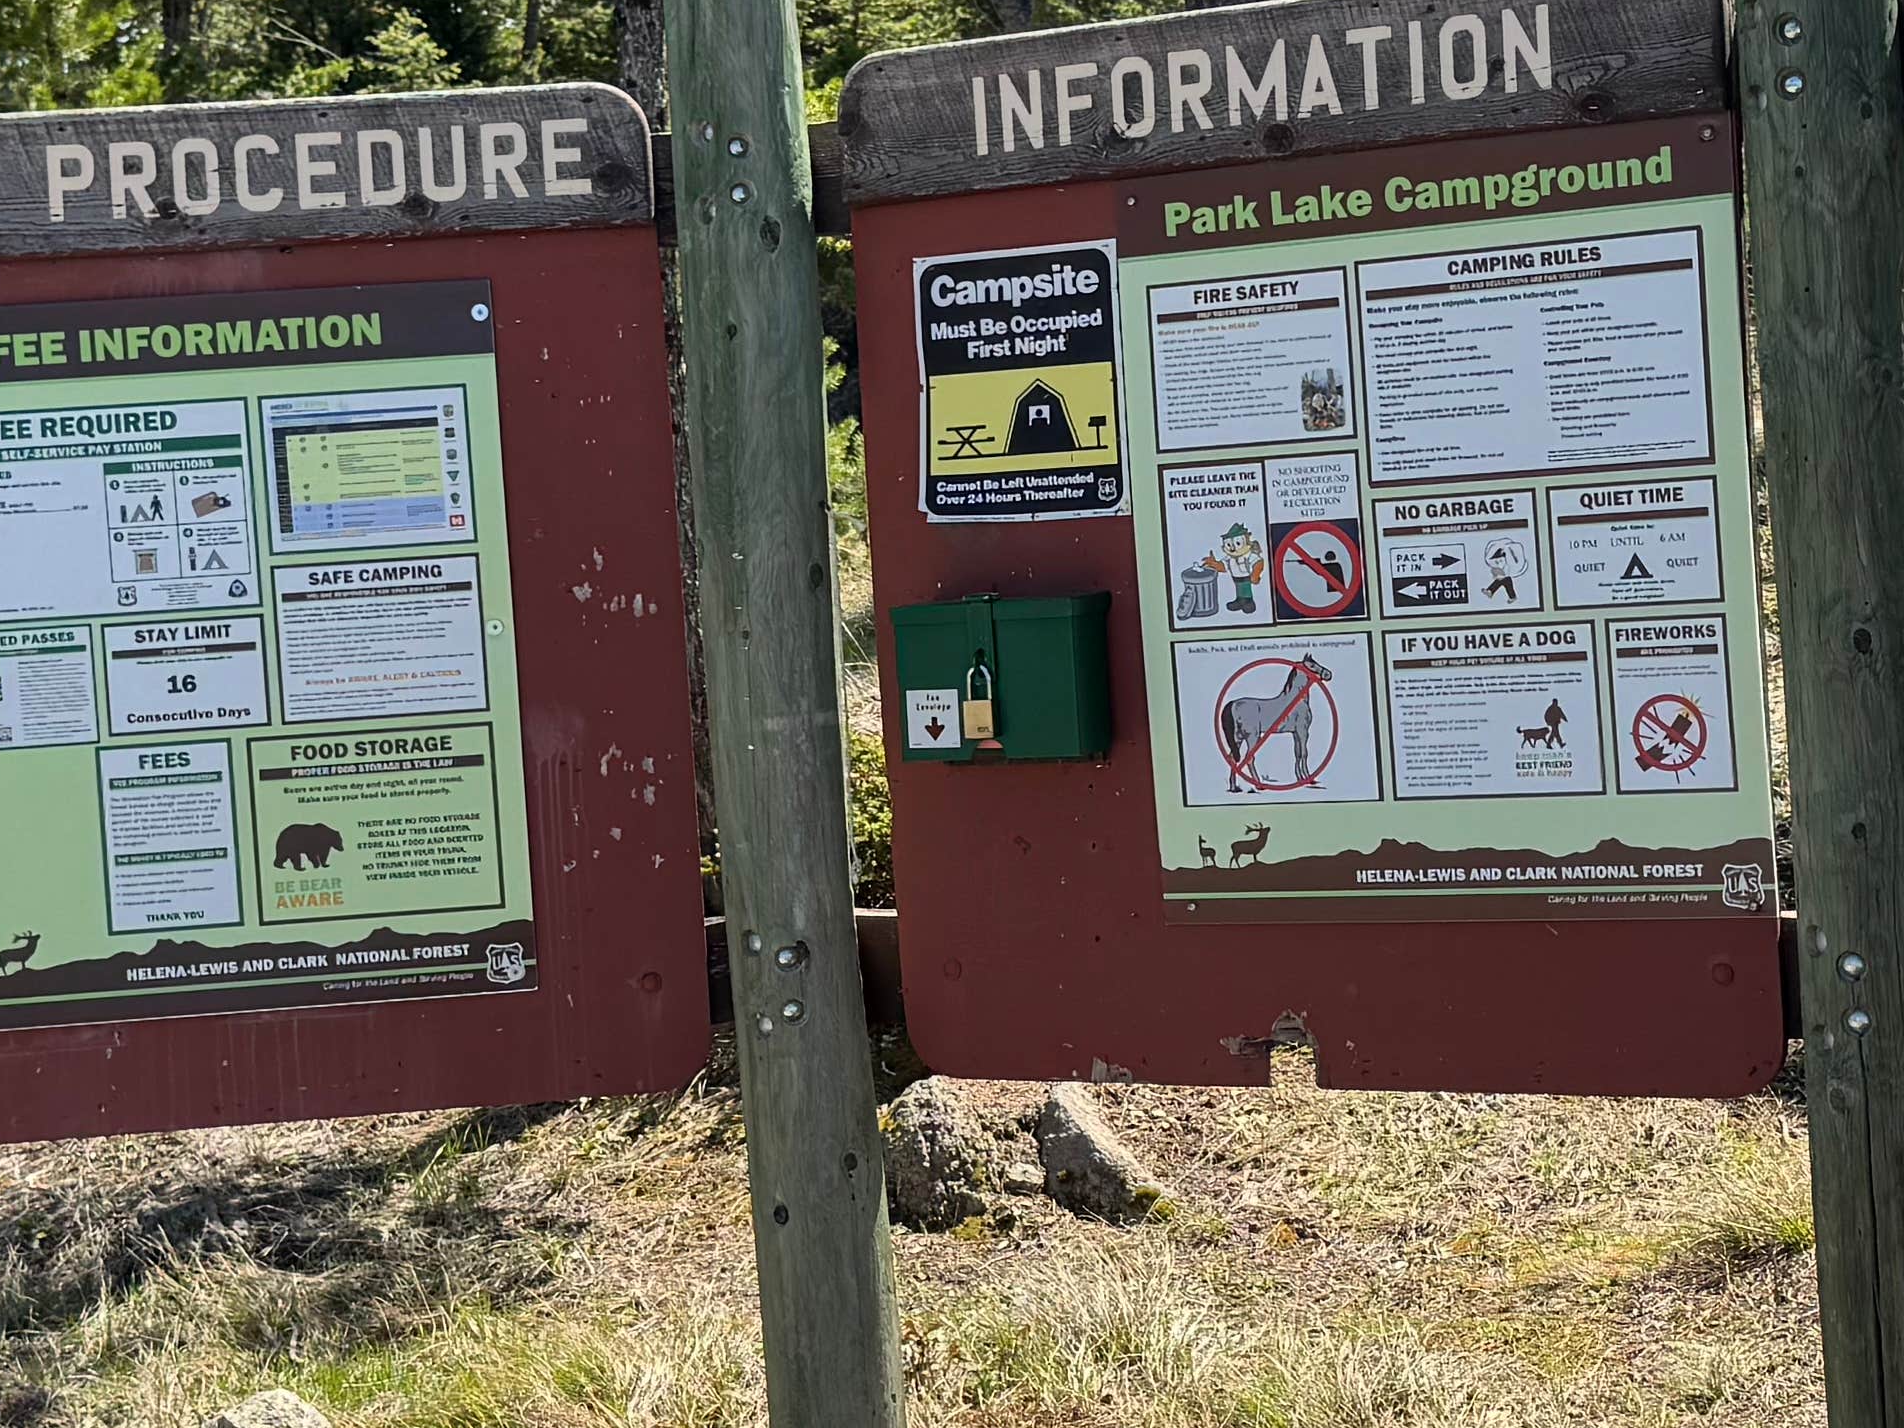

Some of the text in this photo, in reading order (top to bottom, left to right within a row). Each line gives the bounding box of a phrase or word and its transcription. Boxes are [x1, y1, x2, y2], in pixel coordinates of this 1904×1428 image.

[973, 4, 1553, 156] INFORMATION
[48, 117, 593, 223] PROCEDURE
[1165, 147, 1674, 238] Park Lake Campground
[1448, 246, 1602, 276] CAMPING RULES
[930, 264, 1099, 307] Campsite
[1194, 281, 1299, 305] FIRE SAFETY
[931, 308, 1102, 340] Must Be Occupied
[80, 314, 383, 365] INFORMATION
[967, 334, 1066, 359] First Night
[40, 411, 177, 438] REQUIRED
[1, 442, 162, 461] SELF-SERVICE PAY STATION
[132, 459, 214, 472] INSTRUCTIONS
[937, 473, 1094, 492] Cannot Be Left Unattended
[1170, 471, 1256, 486] PLEASE LEAVE THE
[937, 487, 1084, 504] Over 24 Hours Thereafter
[1169, 485, 1259, 498] SITE CLEANER THAN
[1580, 487, 1683, 509] QUIET TIME
[1183, 499, 1246, 511] YOU FOUND IT
[1395, 499, 1514, 520] NO GARBAGE
[1569, 533, 1686, 549] 10 PM UNTIL 6 AM
[1397, 553, 1425, 562] PACK
[1667, 557, 1698, 568] QUIET
[309, 565, 442, 586] SAFE CAMPING
[1397, 563, 1421, 572] IT IN
[1574, 563, 1605, 573] QUIET
[1430, 580, 1459, 588] PACK
[1430, 589, 1466, 599] IT OUT
[22, 632, 75, 644] PASSES
[135, 625, 231, 644] STAY LIMIT
[1402, 630, 1575, 653] IF YOU HAVE A DOG
[1615, 625, 1716, 642] FIREWORKS
[167, 675, 197, 693] 16
[127, 707, 251, 724] Consecutive Days
[291, 735, 453, 761] FOOD STORAGE
[139, 752, 191, 770] FEES
[1357, 864, 1703, 883] HELENA-LEWIS AND CLARK NATIONAL FOREST
[275, 878, 342, 893] BE BEAR
[277, 892, 344, 909] AWARE
[146, 911, 204, 922] THANK YOU
[127, 944, 470, 981] HELENA-LEWIS AND CLARK NATIONAL FOREST
